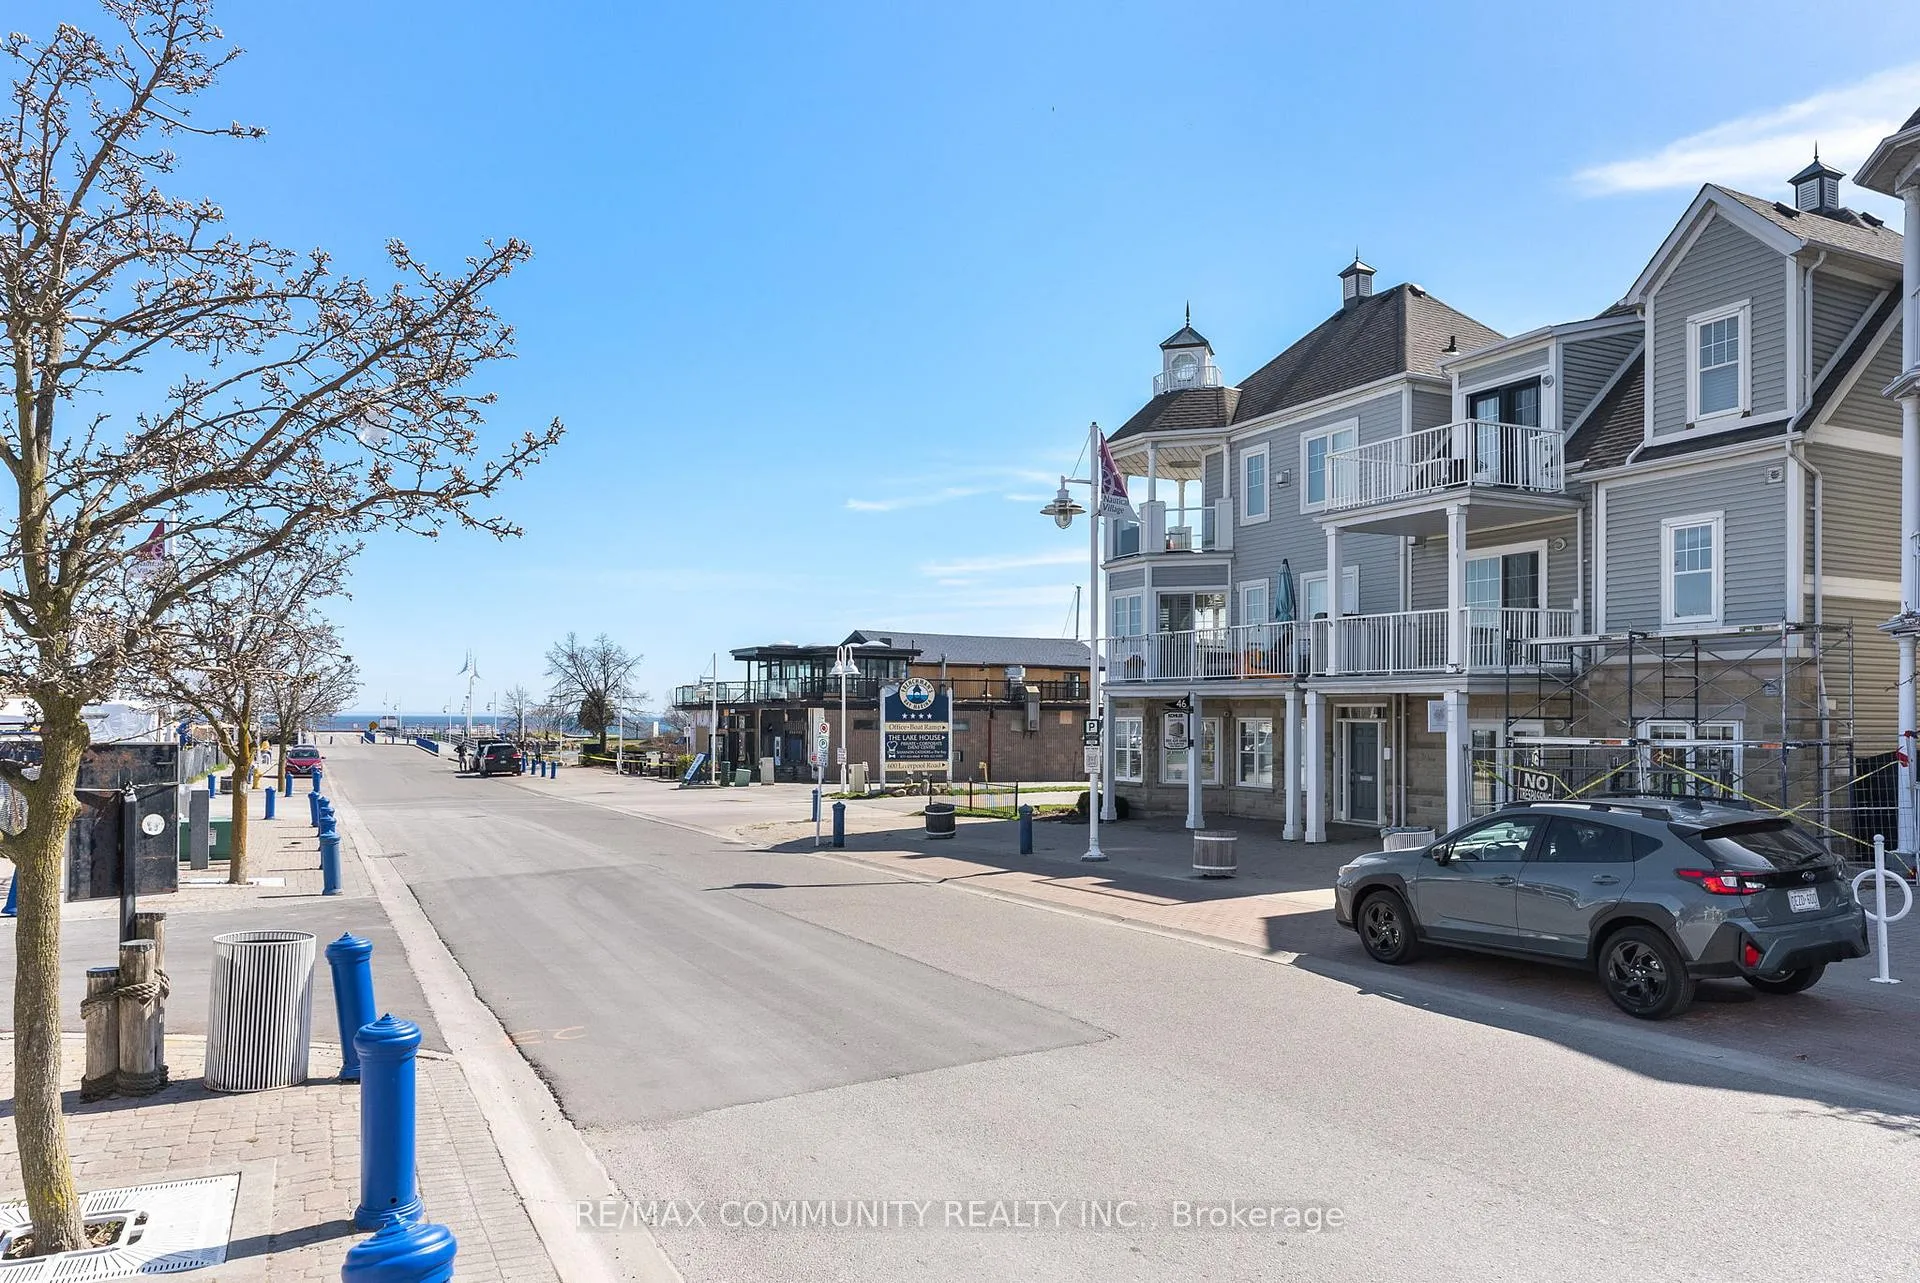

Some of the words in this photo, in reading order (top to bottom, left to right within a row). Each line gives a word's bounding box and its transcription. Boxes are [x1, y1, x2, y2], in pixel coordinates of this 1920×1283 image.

[1102, 503, 1125, 515] Village
[1176, 699, 1187, 708] 46
[1524, 773, 1548, 791] NO
